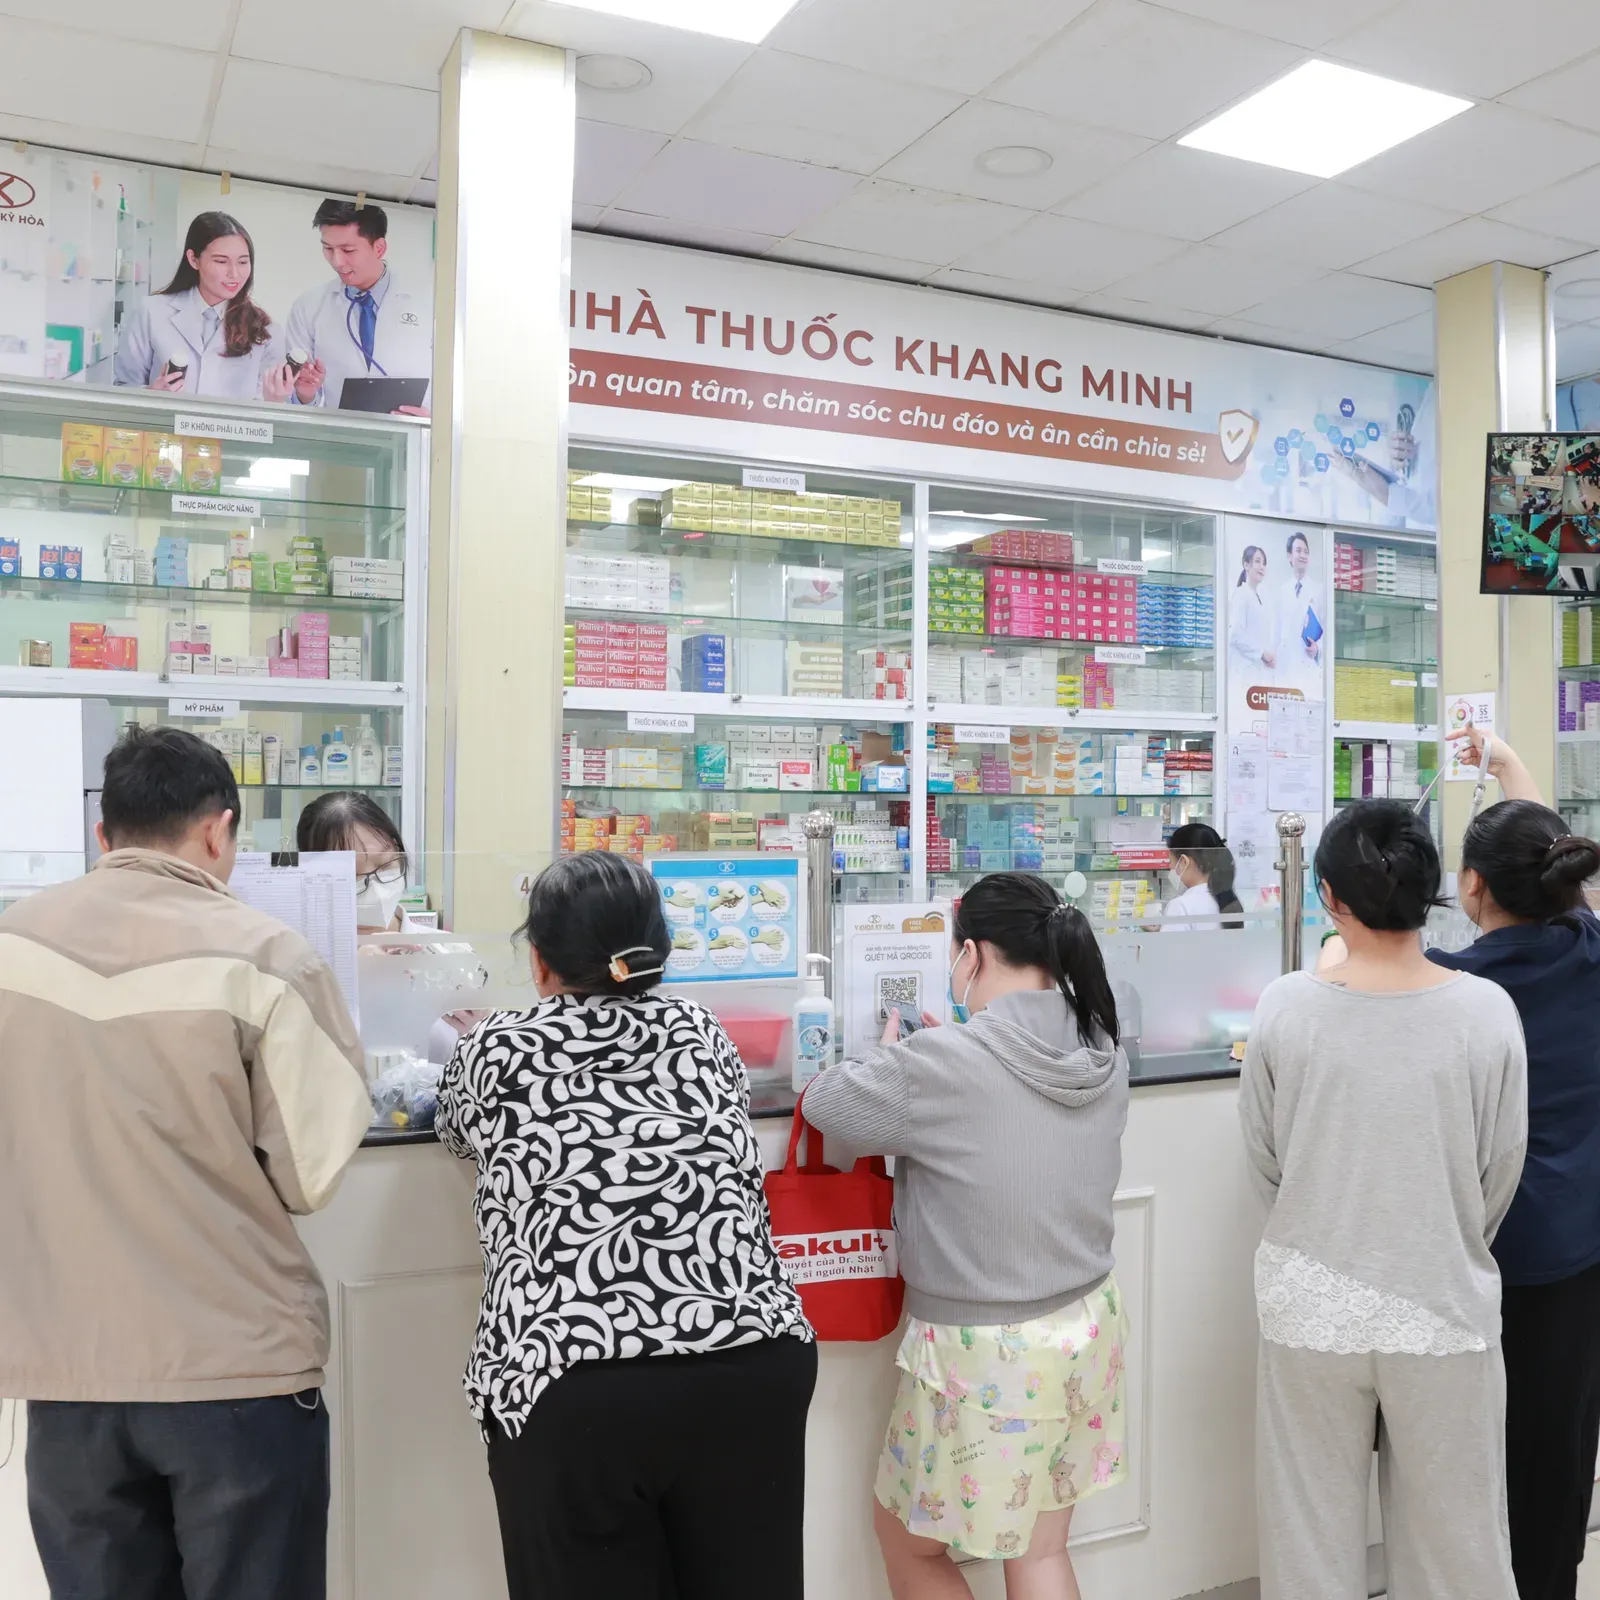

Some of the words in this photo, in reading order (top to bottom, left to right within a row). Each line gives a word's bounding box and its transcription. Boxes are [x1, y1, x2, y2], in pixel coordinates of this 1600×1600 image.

[0, 212, 15, 222] KỲ
[19, 214, 45, 227] HÒA
[570, 288, 666, 340] HÀ
[685, 305, 874, 367] THUỐC
[895, 336, 1063, 394] KHANG
[1082, 365, 1192, 414] MINH
[605, 371, 682, 398] quan
[691, 379, 754, 411] tâm,
[763, 389, 839, 416] chăm
[847, 400, 892, 423] sóc
[898, 405, 946, 430] chu
[952, 411, 1000, 436] đáo
[1006, 420, 1036, 440] và
[1041, 423, 1071, 445] ân
[1077, 428, 1119, 452] cần
[1124, 436, 1171, 459] chia
[1176, 440, 1207, 464] sẻ!
[191, 421, 215, 432] KHÔNG
[216, 424, 233, 433] PHẢI
[245, 427, 268, 437] THUỐC
[749, 474, 764, 482] THUỐC
[766, 475, 781, 484] KHÔNG
[179, 500, 196, 510] THỰC
[197, 501, 216, 511] PHẨM
[217, 503, 234, 512] CHỨC
[236, 504, 254, 514] NĂNG
[1, 545, 17, 558] JEX
[41, 550, 58, 562] JEX
[63, 551, 81, 563] JEX
[1102, 561, 1117, 570] THUỐC
[1118, 562, 1131, 571] ĐÔNG
[579, 623, 604, 631] Philiver
[609, 625, 635, 634] Philiver
[640, 627, 665, 636] Philiver
[578, 637, 603, 645] Philiver
[609, 639, 634, 647] Philiver
[640, 641, 665, 649] Philiver
[578, 651, 603, 659] Philiver
[609, 652, 634, 661] Philiver
[640, 654, 665, 662] Philiver
[578, 665, 603, 673] Philiver
[609, 666, 634, 674] Philiver
[639, 668, 665, 676] Philiver
[578, 678, 602, 686] Philiver
[609, 679, 634, 687] Philiver
[639, 681, 664, 689] Philiver
[185, 703, 198, 713] MỸ
[199, 704, 224, 713] PHẨM
[1479, 707, 1488, 716] 5S
[634, 717, 651, 726] THUỐC
[652, 718, 669, 727] KHÔNG
[520, 876, 531, 895] 4
[864, 952, 884, 961] QUÉT
[887, 951, 898, 960] MÃ
[900, 952, 932, 960] QRCODE
[816, 1257, 835, 1267] của
[839, 1256, 853, 1264] Dr.
[857, 1255, 883, 1263] Shiro
[803, 1270, 812, 1278] sĩ
[816, 1267, 845, 1278] người
[849, 1265, 875, 1275] Nhật
